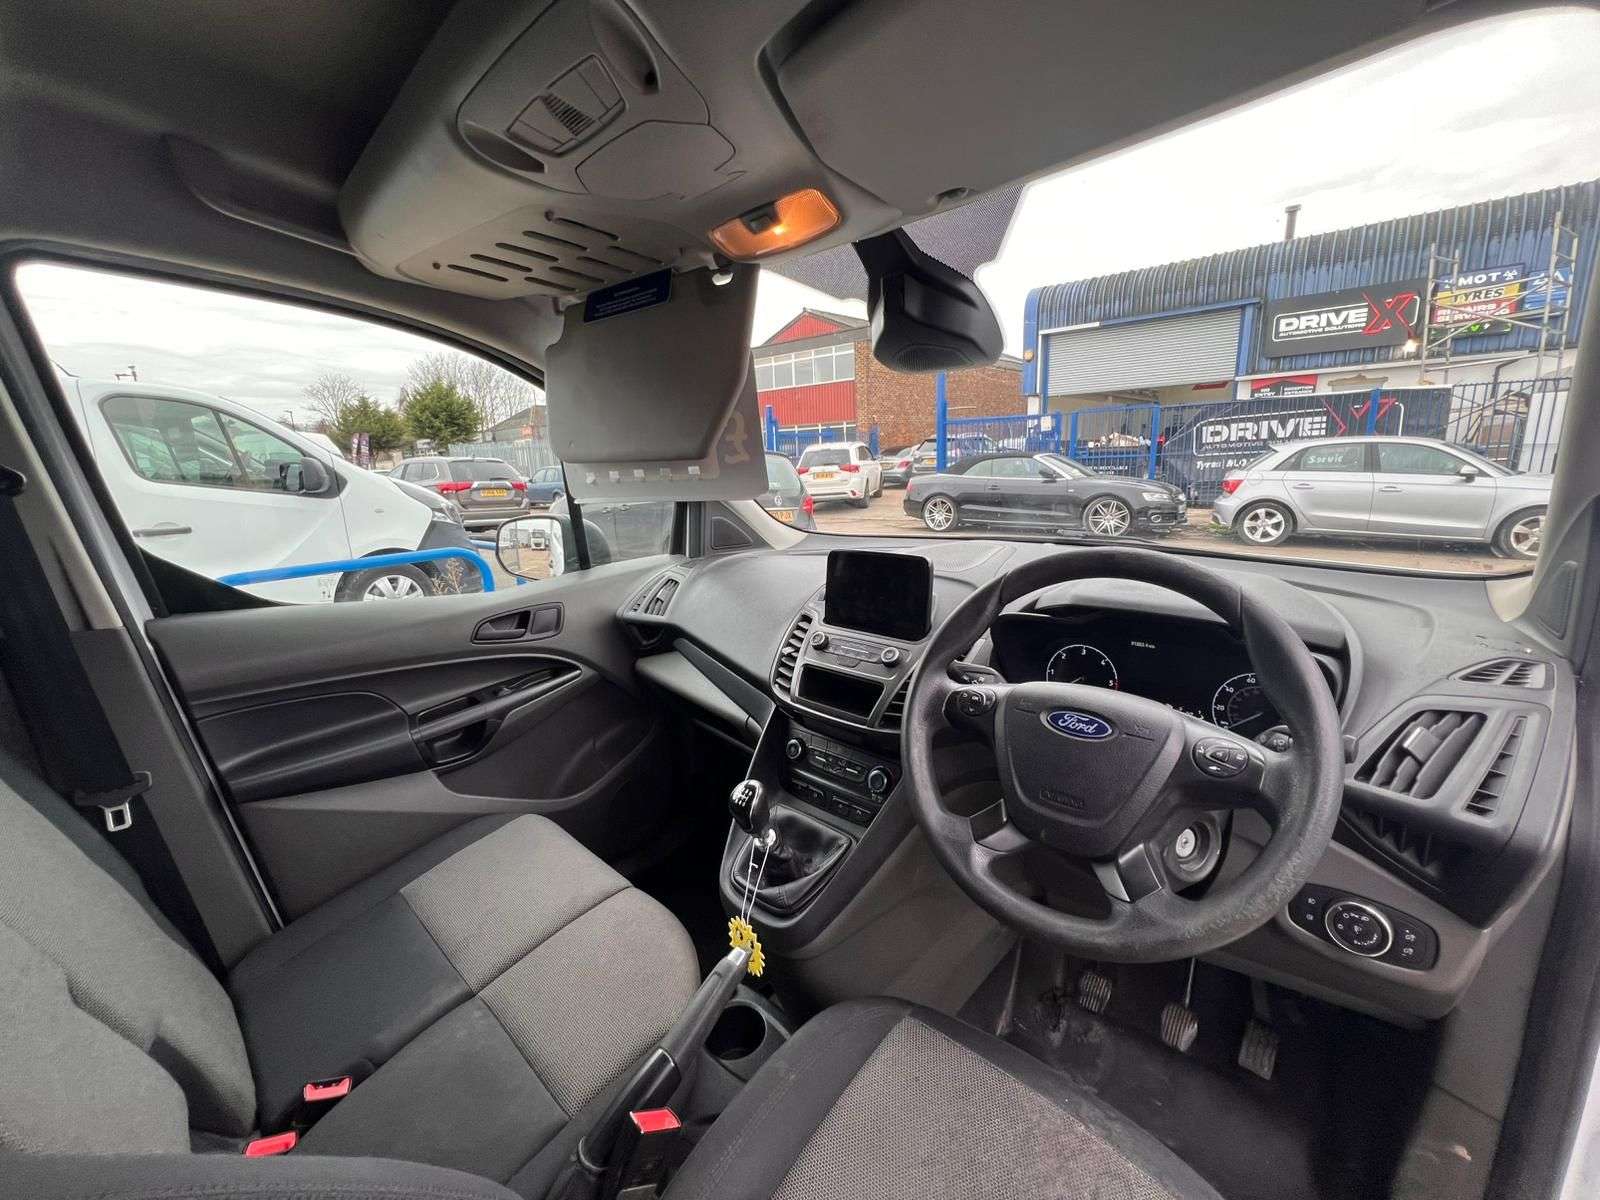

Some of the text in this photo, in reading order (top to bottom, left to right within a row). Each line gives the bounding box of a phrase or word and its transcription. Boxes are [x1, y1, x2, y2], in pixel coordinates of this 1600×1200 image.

[1457, 272, 1501, 287] MOT
[1454, 288, 1504, 304] TYRES
[1278, 307, 1369, 333] DRIVE
[1278, 322, 1368, 337] AUTOMOTIVE SOLUTIONS
[1201, 416, 1327, 443] DRIVE
[1202, 441, 1264, 450] AUTOMOTIVE
[1058, 713, 1099, 734] Ford
